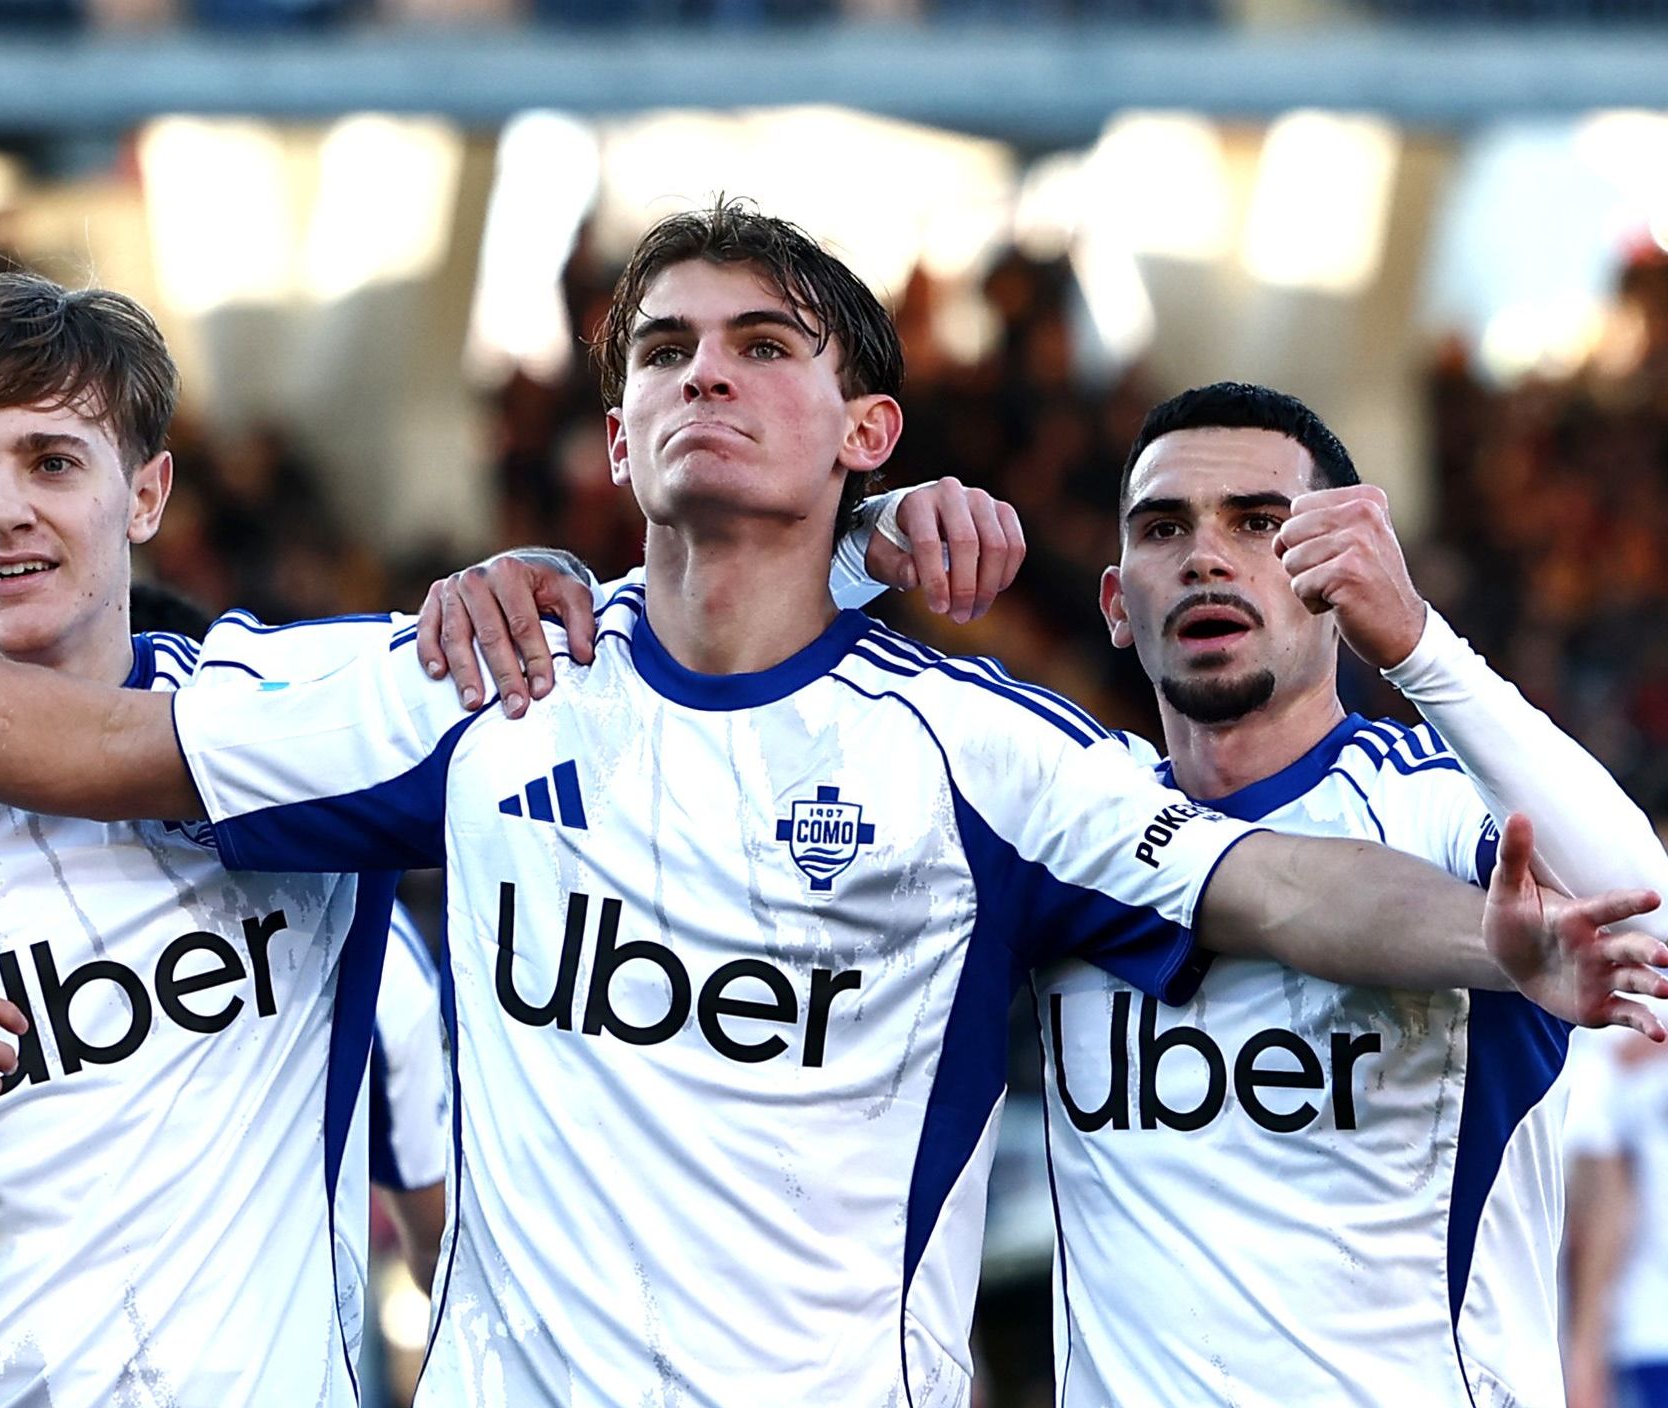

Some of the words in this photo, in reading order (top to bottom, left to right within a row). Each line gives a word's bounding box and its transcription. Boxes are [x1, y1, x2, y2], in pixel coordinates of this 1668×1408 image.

[796, 819, 854, 845] COMO
[809, 807, 844, 819] 1907
[496, 881, 862, 1068] Uber
[1048, 991, 1382, 1133] Uber
